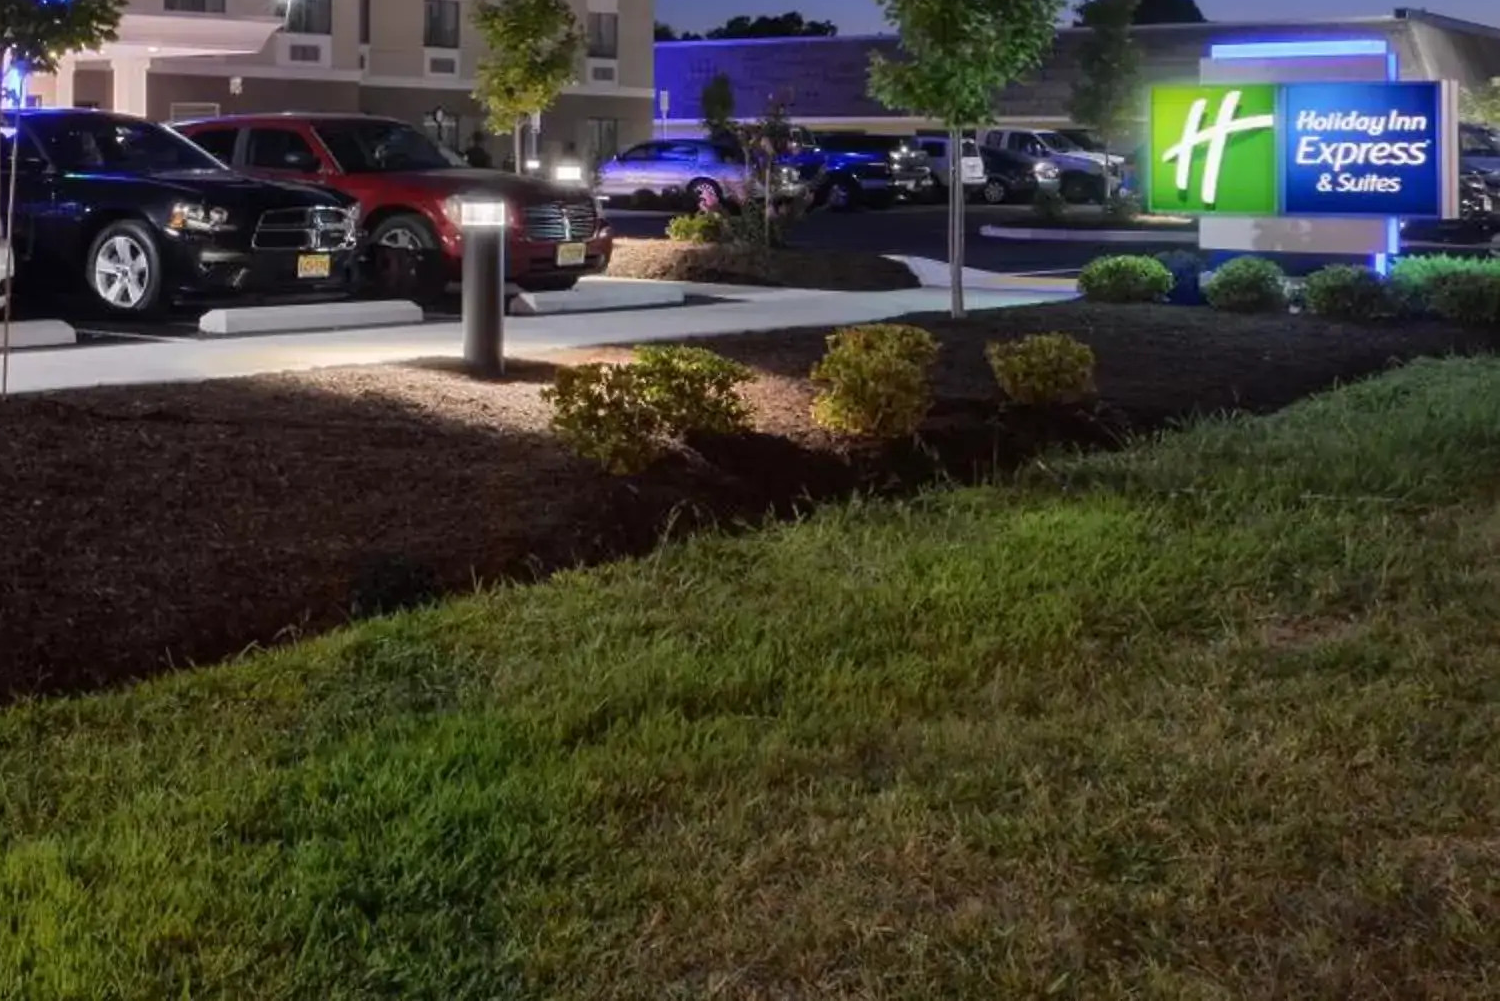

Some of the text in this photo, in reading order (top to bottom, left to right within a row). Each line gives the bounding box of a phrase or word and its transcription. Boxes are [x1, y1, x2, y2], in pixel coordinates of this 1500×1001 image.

[1296, 109, 1427, 136] Holiday Inn
[1296, 136, 1428, 172] Express
[1316, 173, 1402, 193] & Suites
